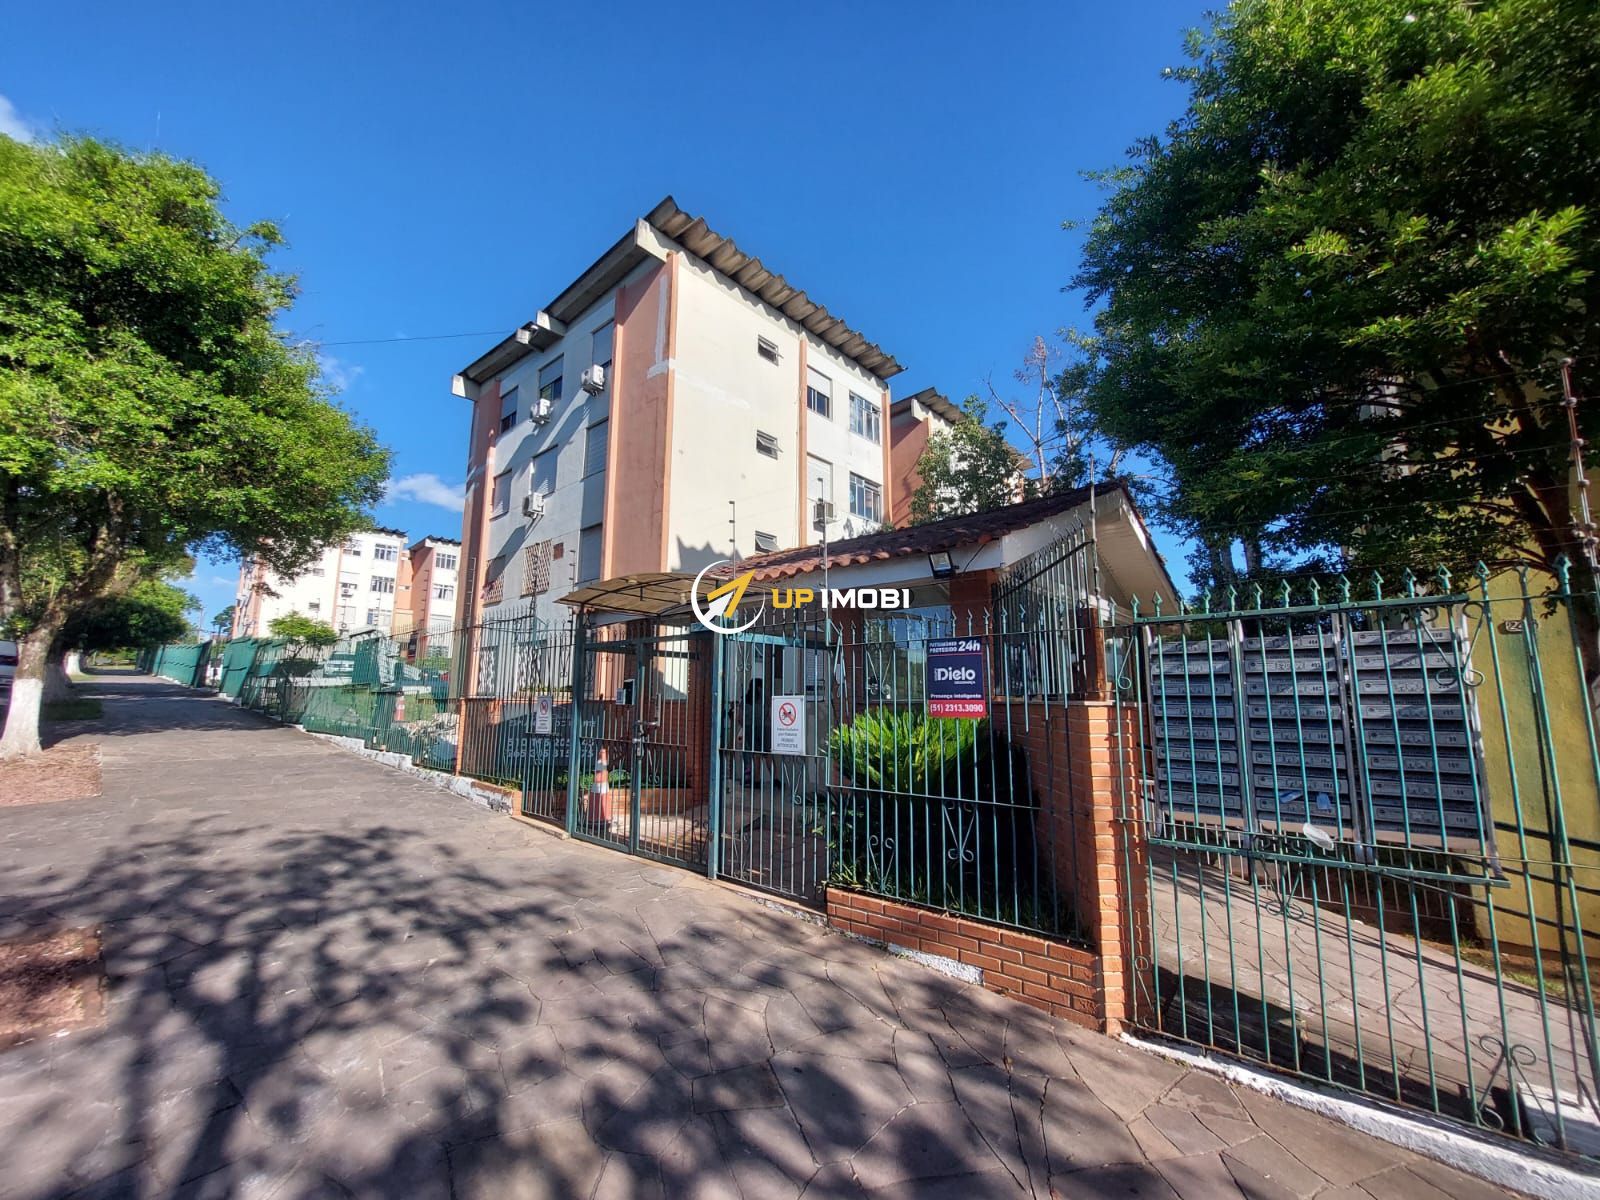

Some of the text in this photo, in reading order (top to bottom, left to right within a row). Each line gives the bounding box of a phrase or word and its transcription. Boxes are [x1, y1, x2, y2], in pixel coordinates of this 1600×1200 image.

[958, 640, 981, 652] 24h
[937, 666, 976, 681] Dielo
[930, 703, 983, 713] (51) 2313.3090
